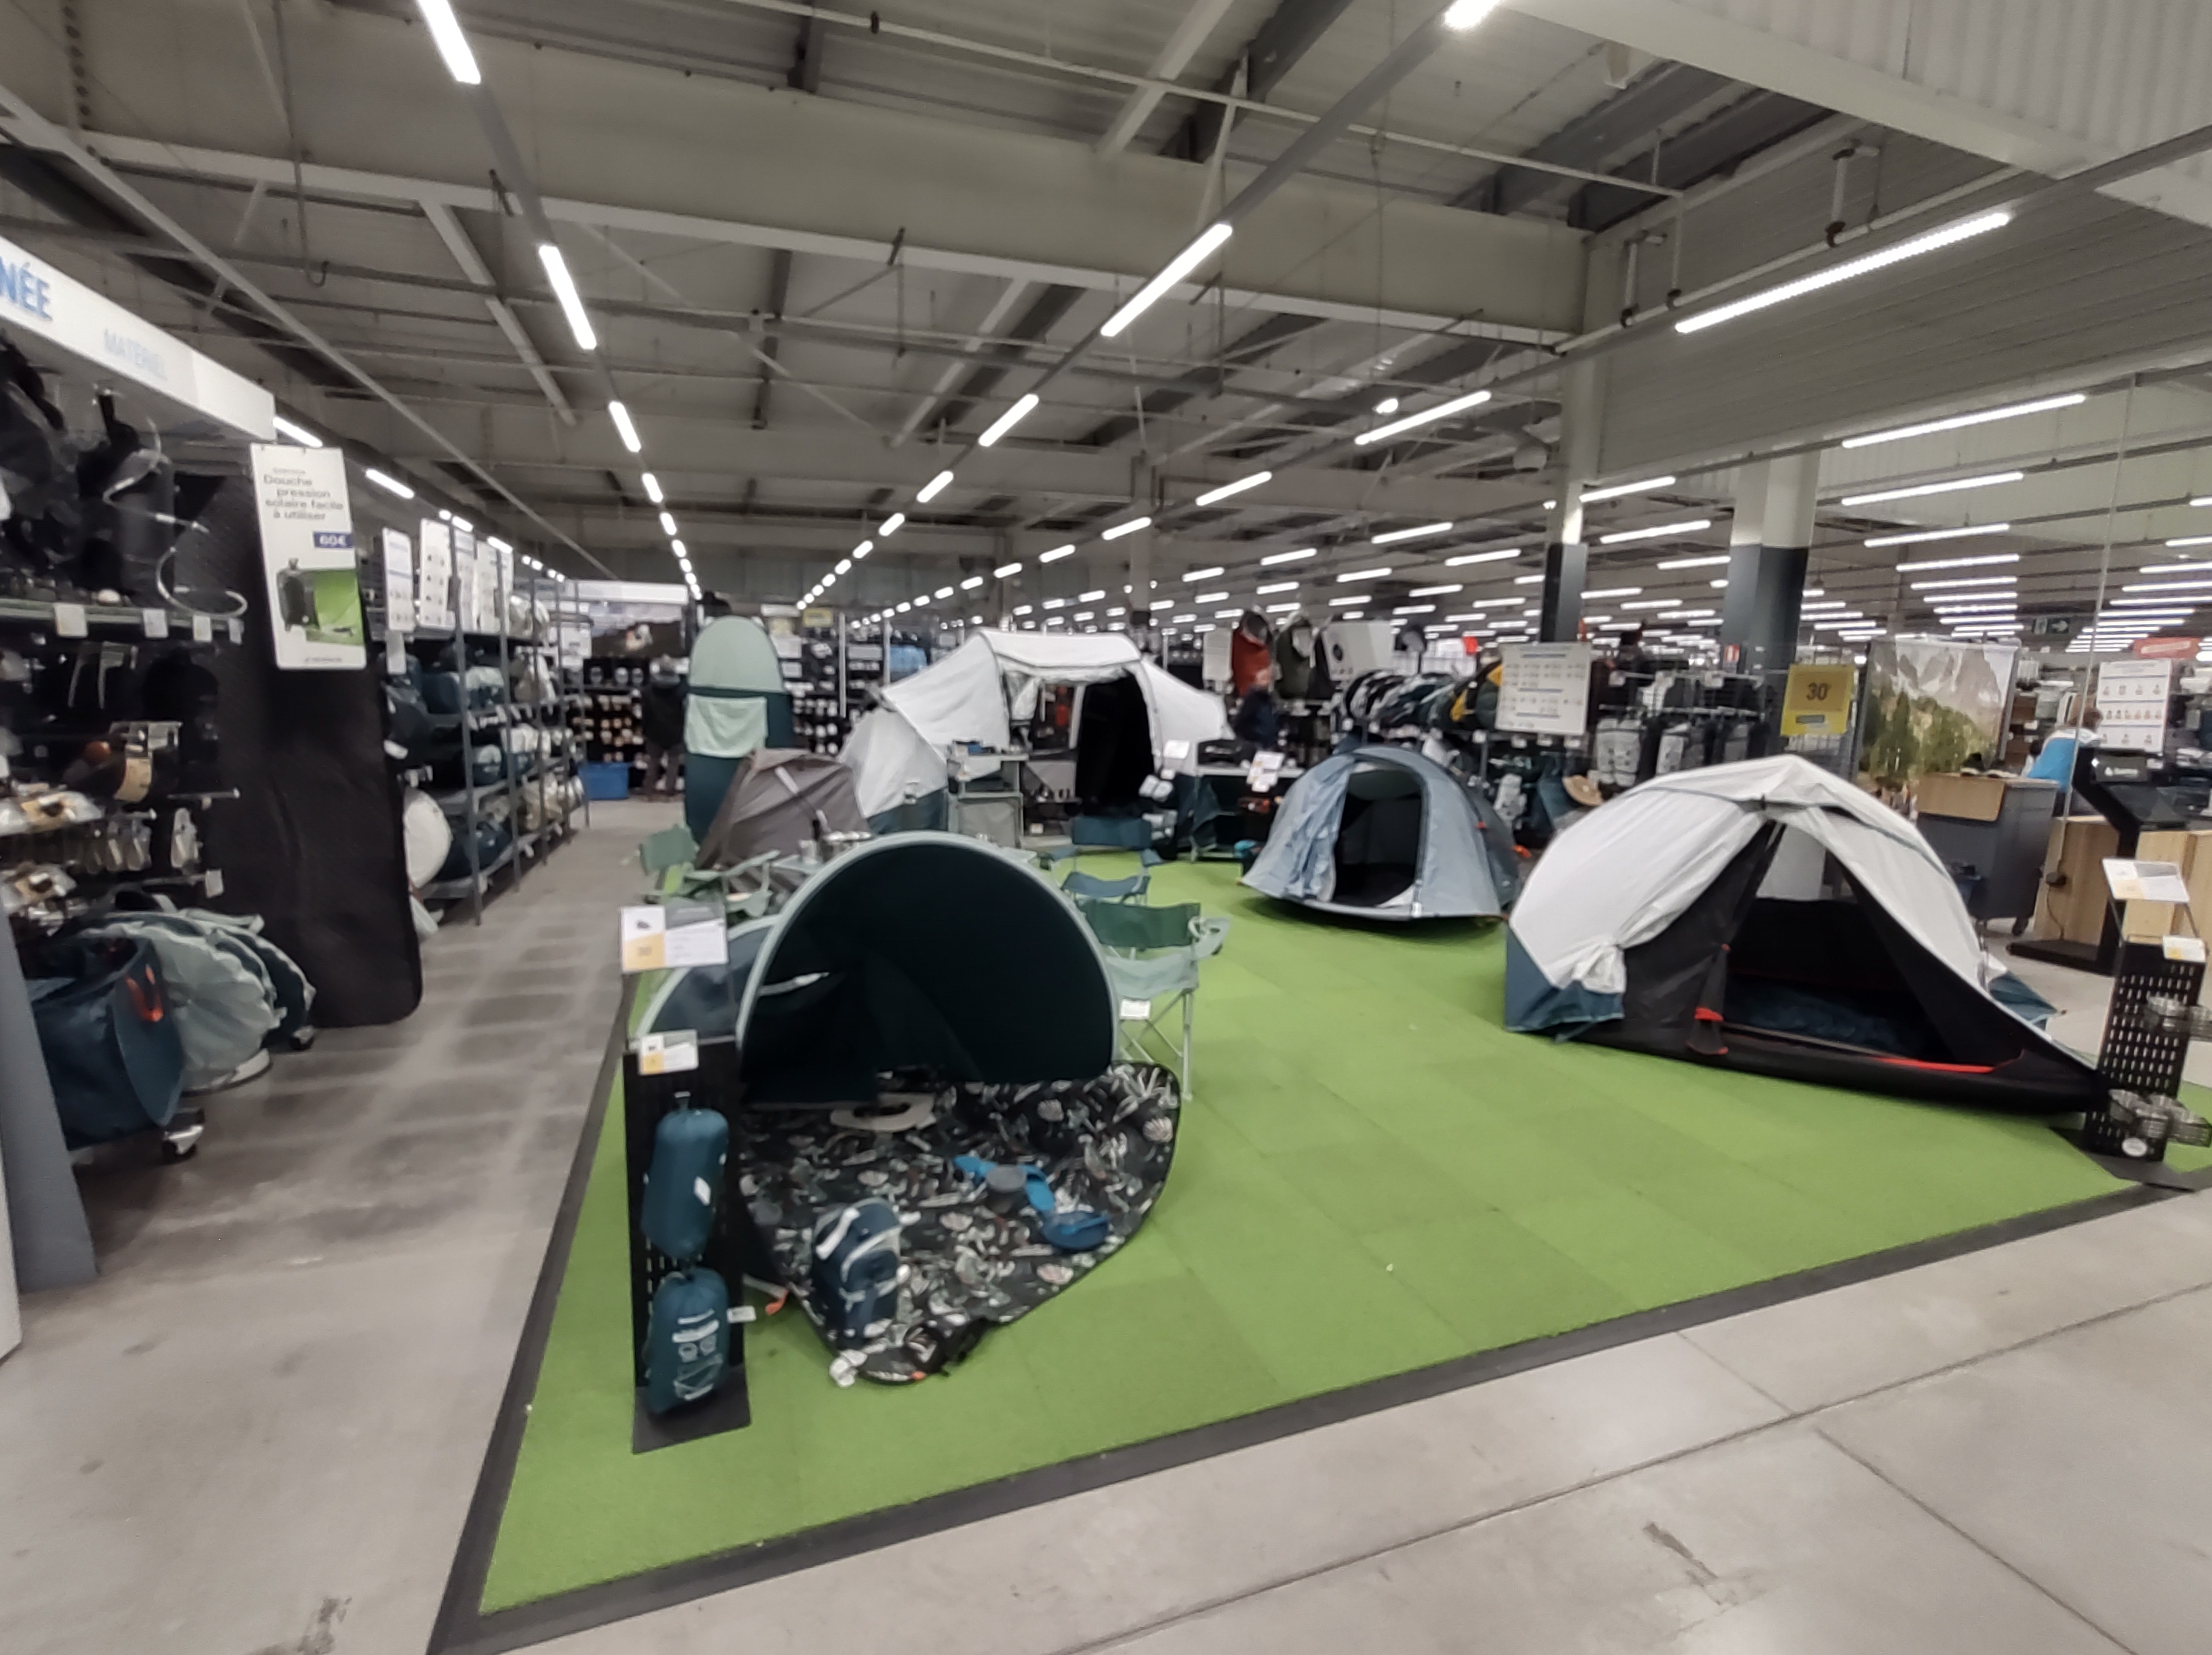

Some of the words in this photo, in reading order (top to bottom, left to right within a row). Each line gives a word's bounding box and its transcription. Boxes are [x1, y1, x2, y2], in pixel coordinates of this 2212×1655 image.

[263, 473, 313, 485] Douche
[276, 489, 331, 498] pression
[311, 499, 344, 510] facile
[285, 511, 326, 520] utiliser
[319, 535, 347, 546] 60€
